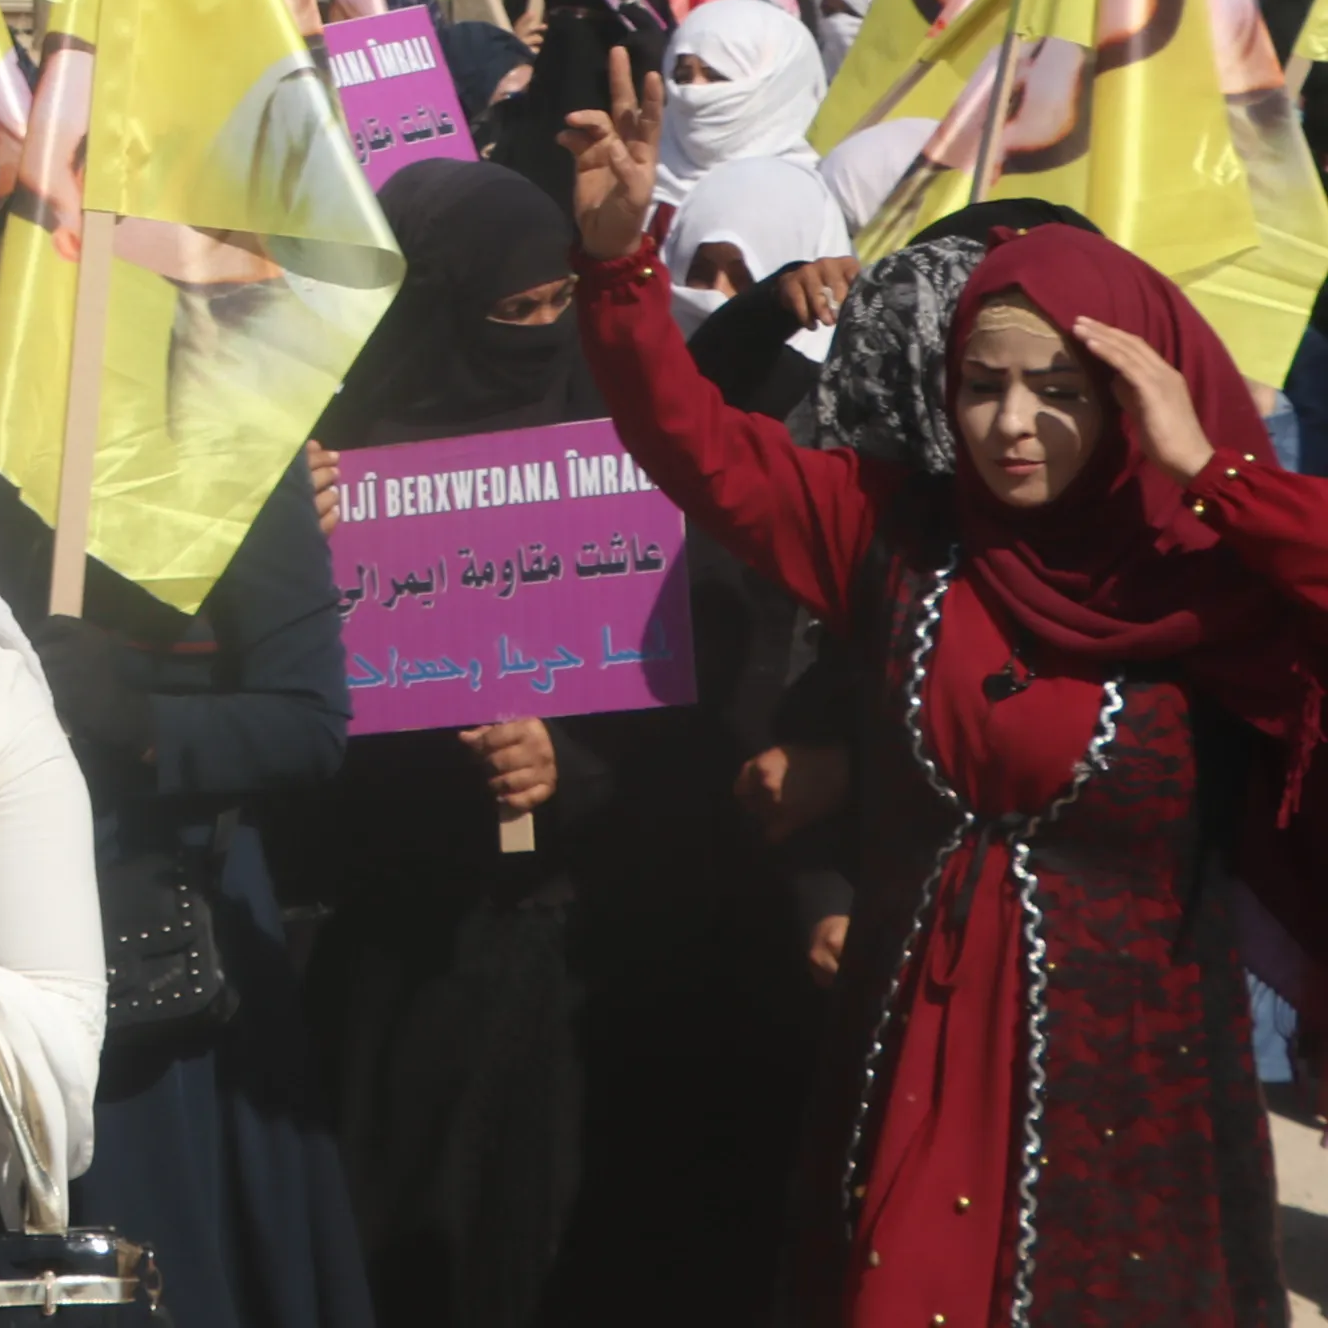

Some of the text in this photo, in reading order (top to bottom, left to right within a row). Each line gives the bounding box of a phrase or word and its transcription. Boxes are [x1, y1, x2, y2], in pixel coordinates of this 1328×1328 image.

[366, 35, 437, 80] ÎMRALI
[336, 449, 659, 522] IJÎ BERXWEDANA ÎMRAL
[459, 542, 565, 599] مقاومة
[575, 532, 668, 578] عاشت
